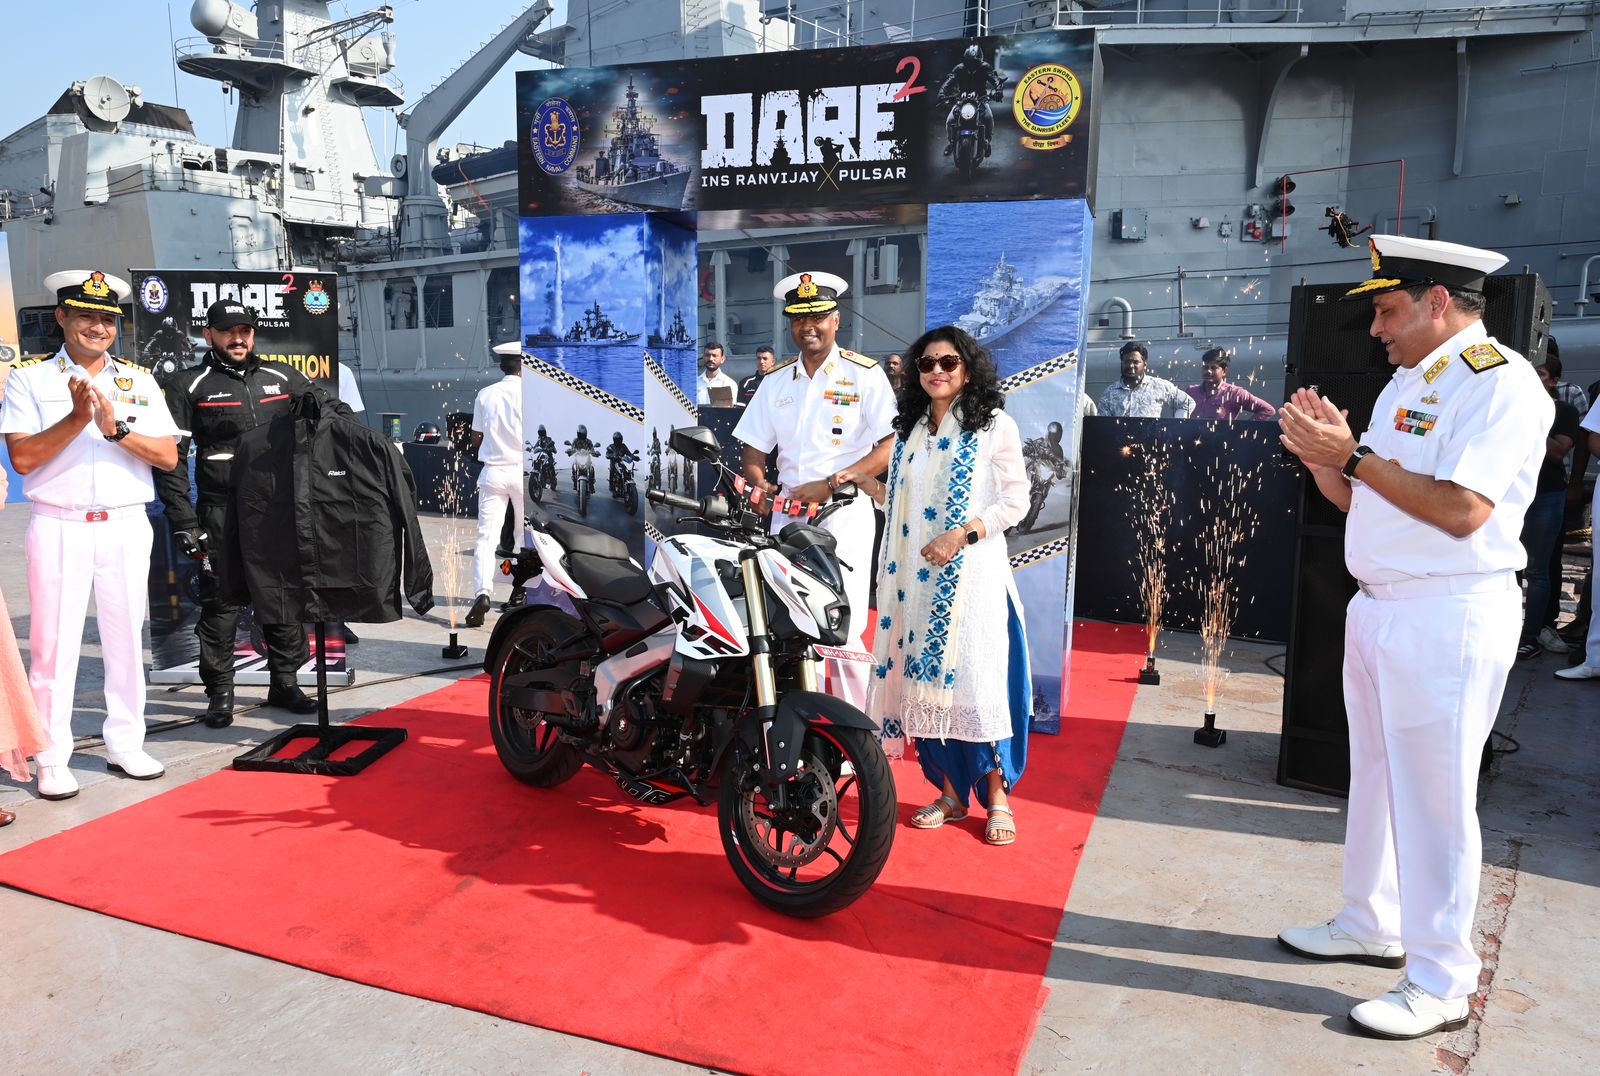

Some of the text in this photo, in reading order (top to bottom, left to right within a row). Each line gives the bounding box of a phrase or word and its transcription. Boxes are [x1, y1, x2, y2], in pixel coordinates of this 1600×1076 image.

[1024, 67, 1073, 85] EASTERN SWORD
[701, 82, 910, 169] DARE
[1021, 114, 1072, 133] THE SUNRISE FLEET
[532, 135, 578, 173] EASTERN NAVAL COMMAND
[701, 174, 730, 188] INS
[736, 170, 819, 186] RANVIJAY
[838, 167, 907, 182] PULSAR
[257, 320, 290, 328] PULSAR
